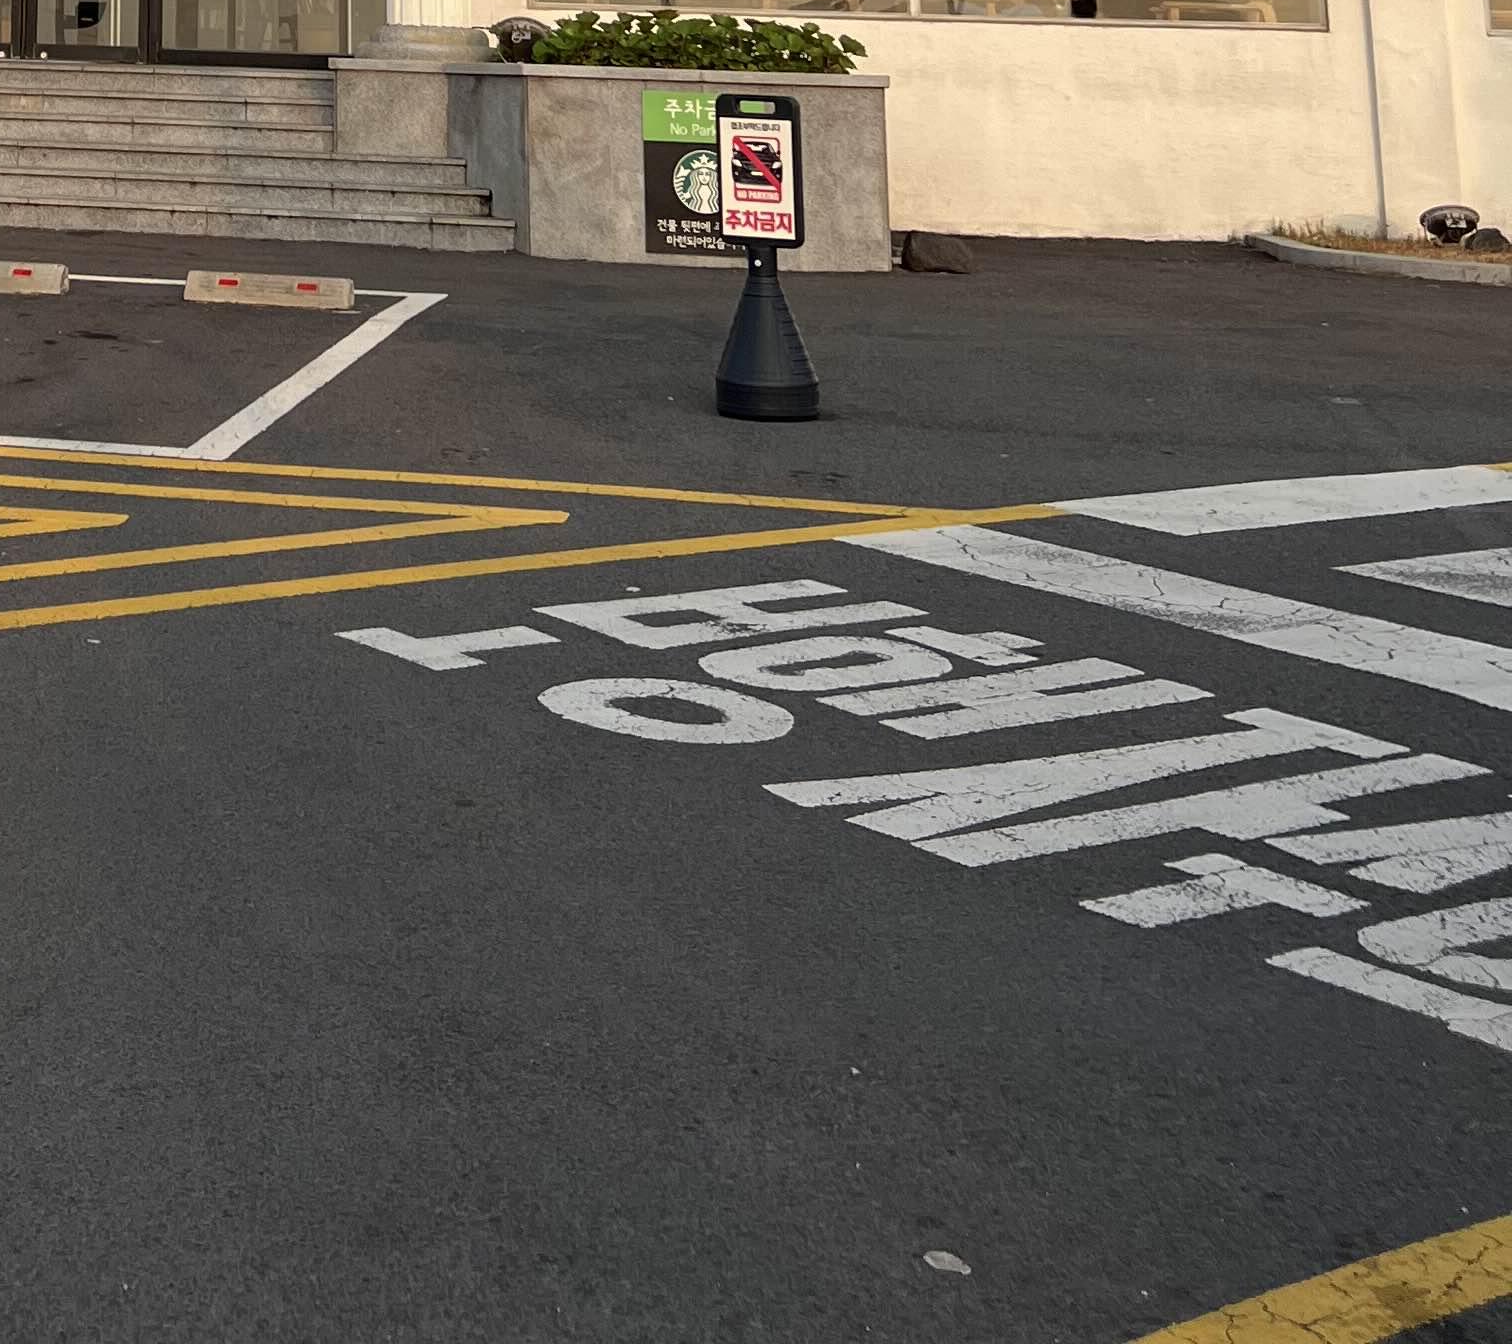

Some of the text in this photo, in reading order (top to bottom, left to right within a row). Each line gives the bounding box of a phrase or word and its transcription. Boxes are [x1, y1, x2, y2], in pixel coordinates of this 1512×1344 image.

[663, 98, 716, 121] 주차금
[670, 122, 716, 137] No Park
[657, 219, 677, 232] 건물
[725, 209, 792, 234] 주차금지
[666, 234, 746, 250] 마련되어있습
